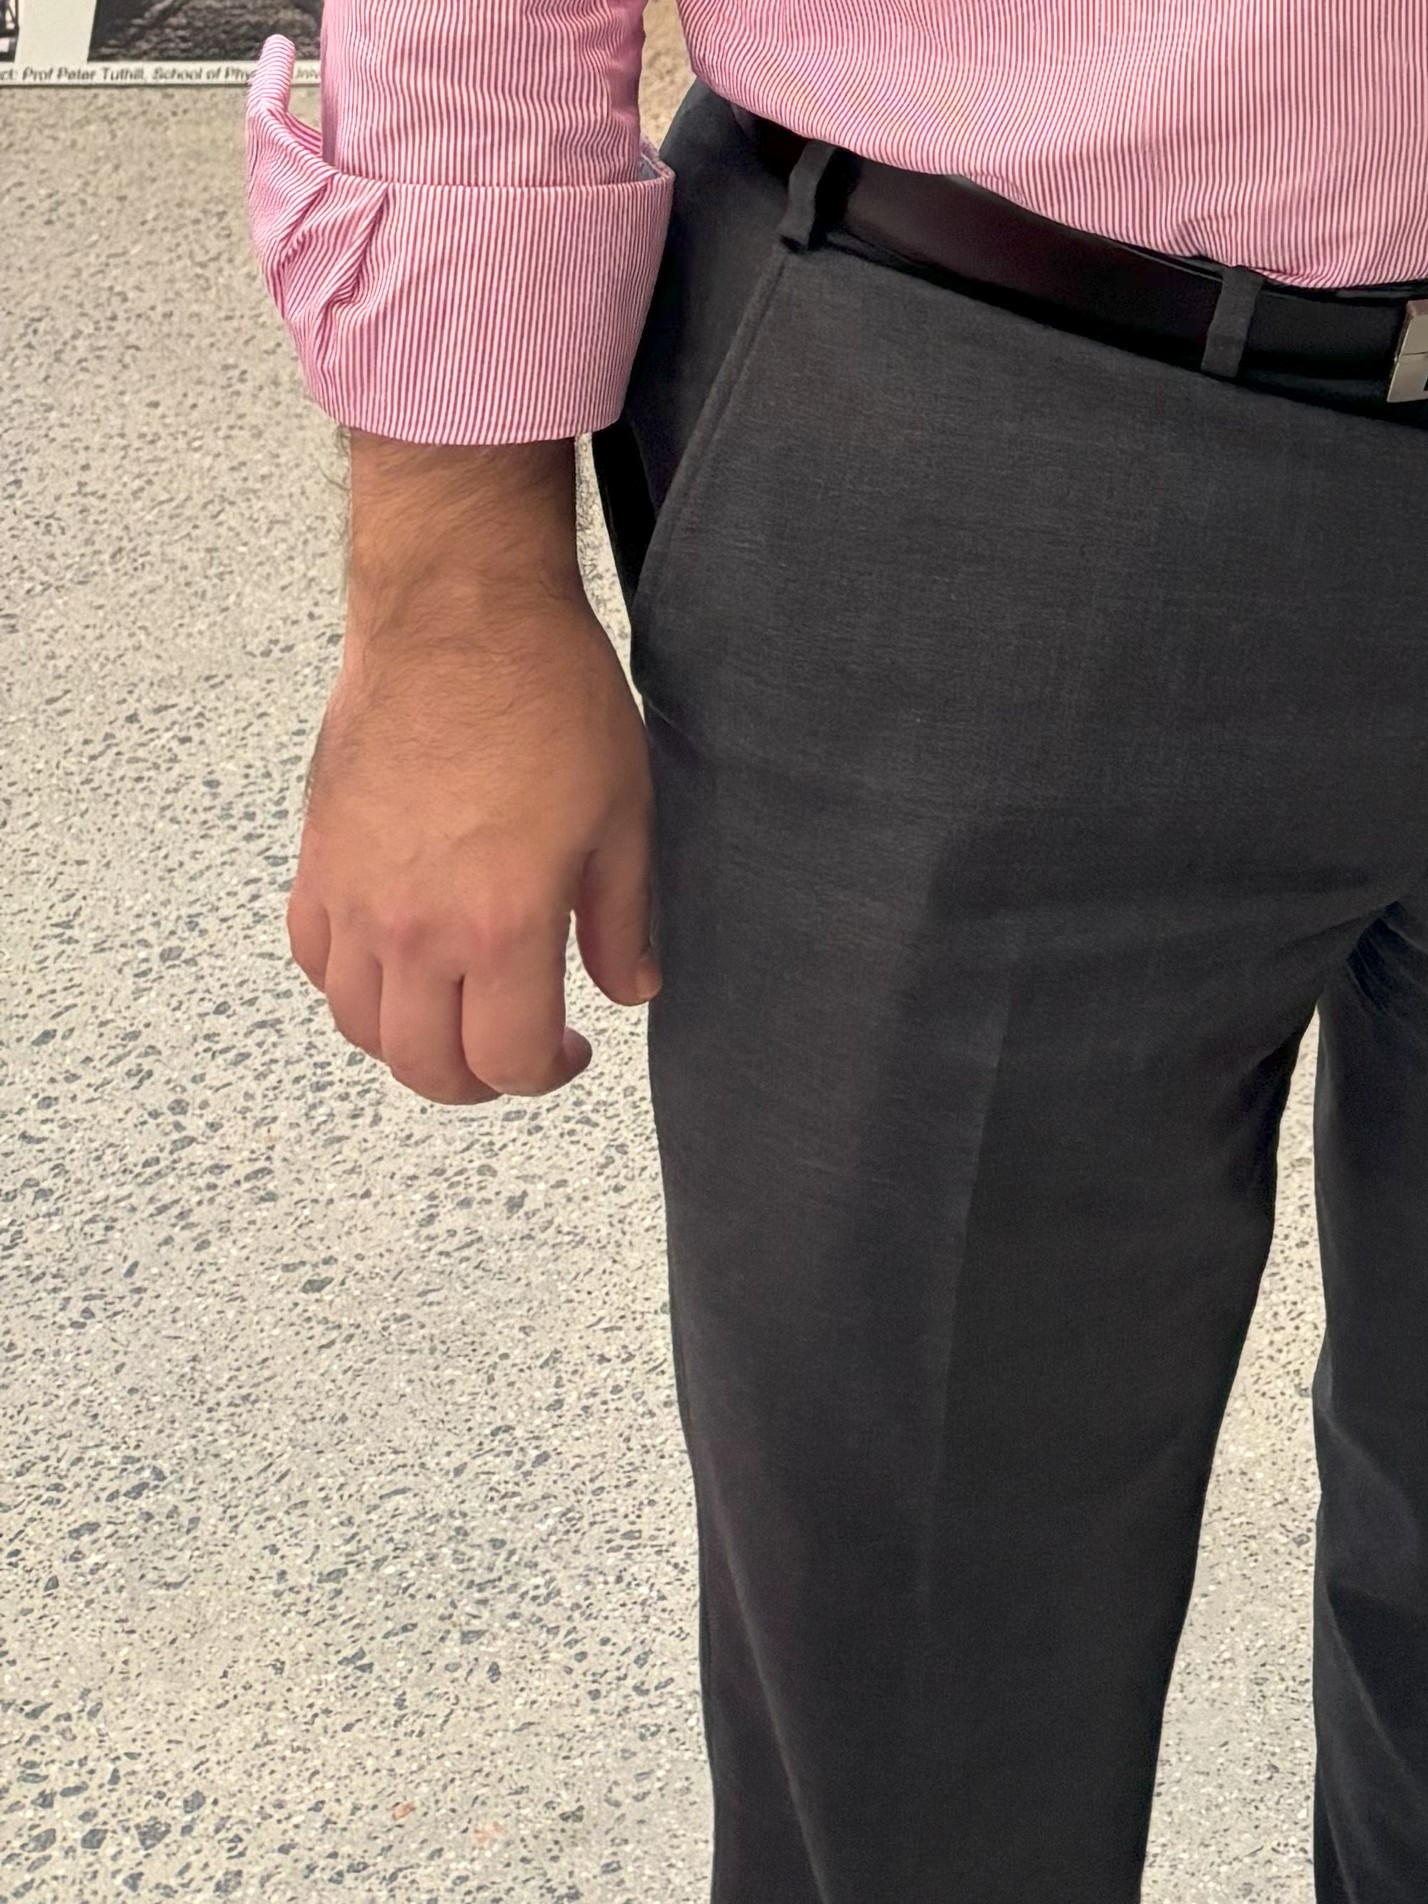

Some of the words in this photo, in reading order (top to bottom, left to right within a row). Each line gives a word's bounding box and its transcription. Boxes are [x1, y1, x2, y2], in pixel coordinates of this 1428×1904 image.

[22, 67, 54, 81] Prof
[57, 66, 96, 80] Peter
[153, 66, 202, 80] School
[206, 67, 221, 80] of
